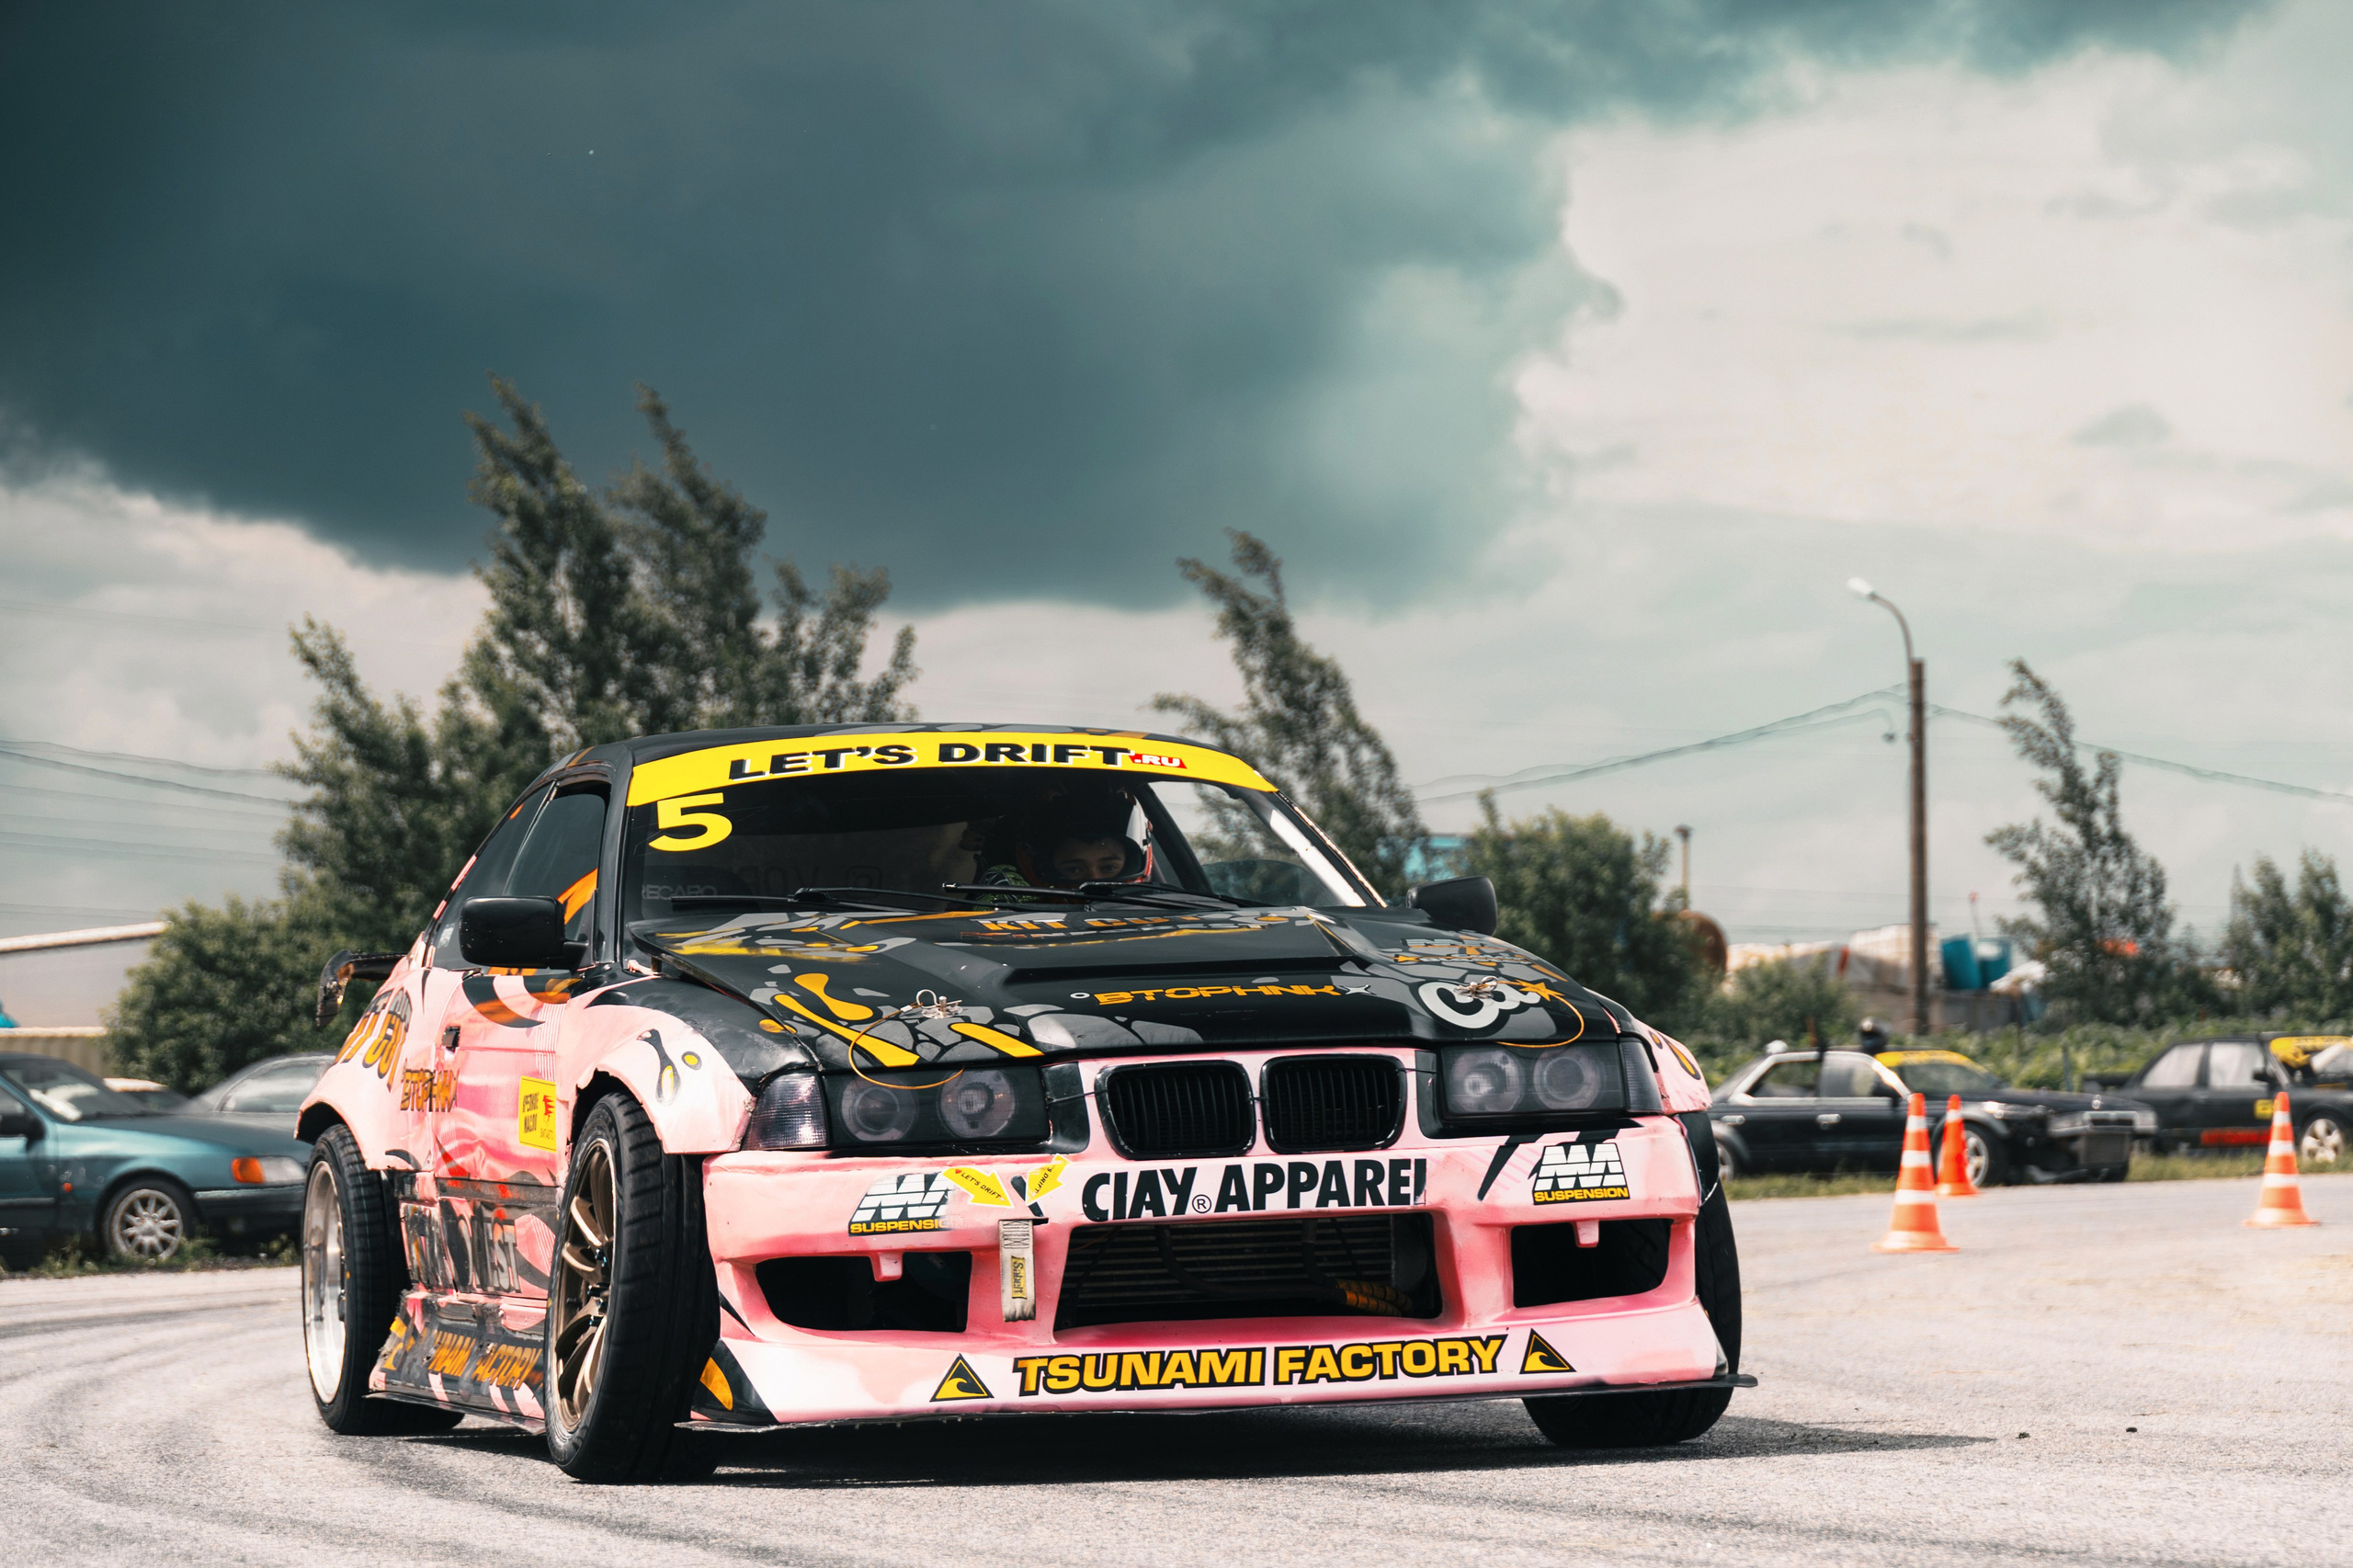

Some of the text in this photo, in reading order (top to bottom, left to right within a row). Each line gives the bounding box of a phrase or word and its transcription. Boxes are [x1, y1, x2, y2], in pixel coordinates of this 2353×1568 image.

[728, 744, 917, 780] LET'S
[648, 792, 733, 852] 5
[961, 1172, 981, 1187] LET'S
[1534, 1187, 1629, 1202] SUSPENSION
[1015, 1336, 1506, 1395] TSUNAMI FACTORY
